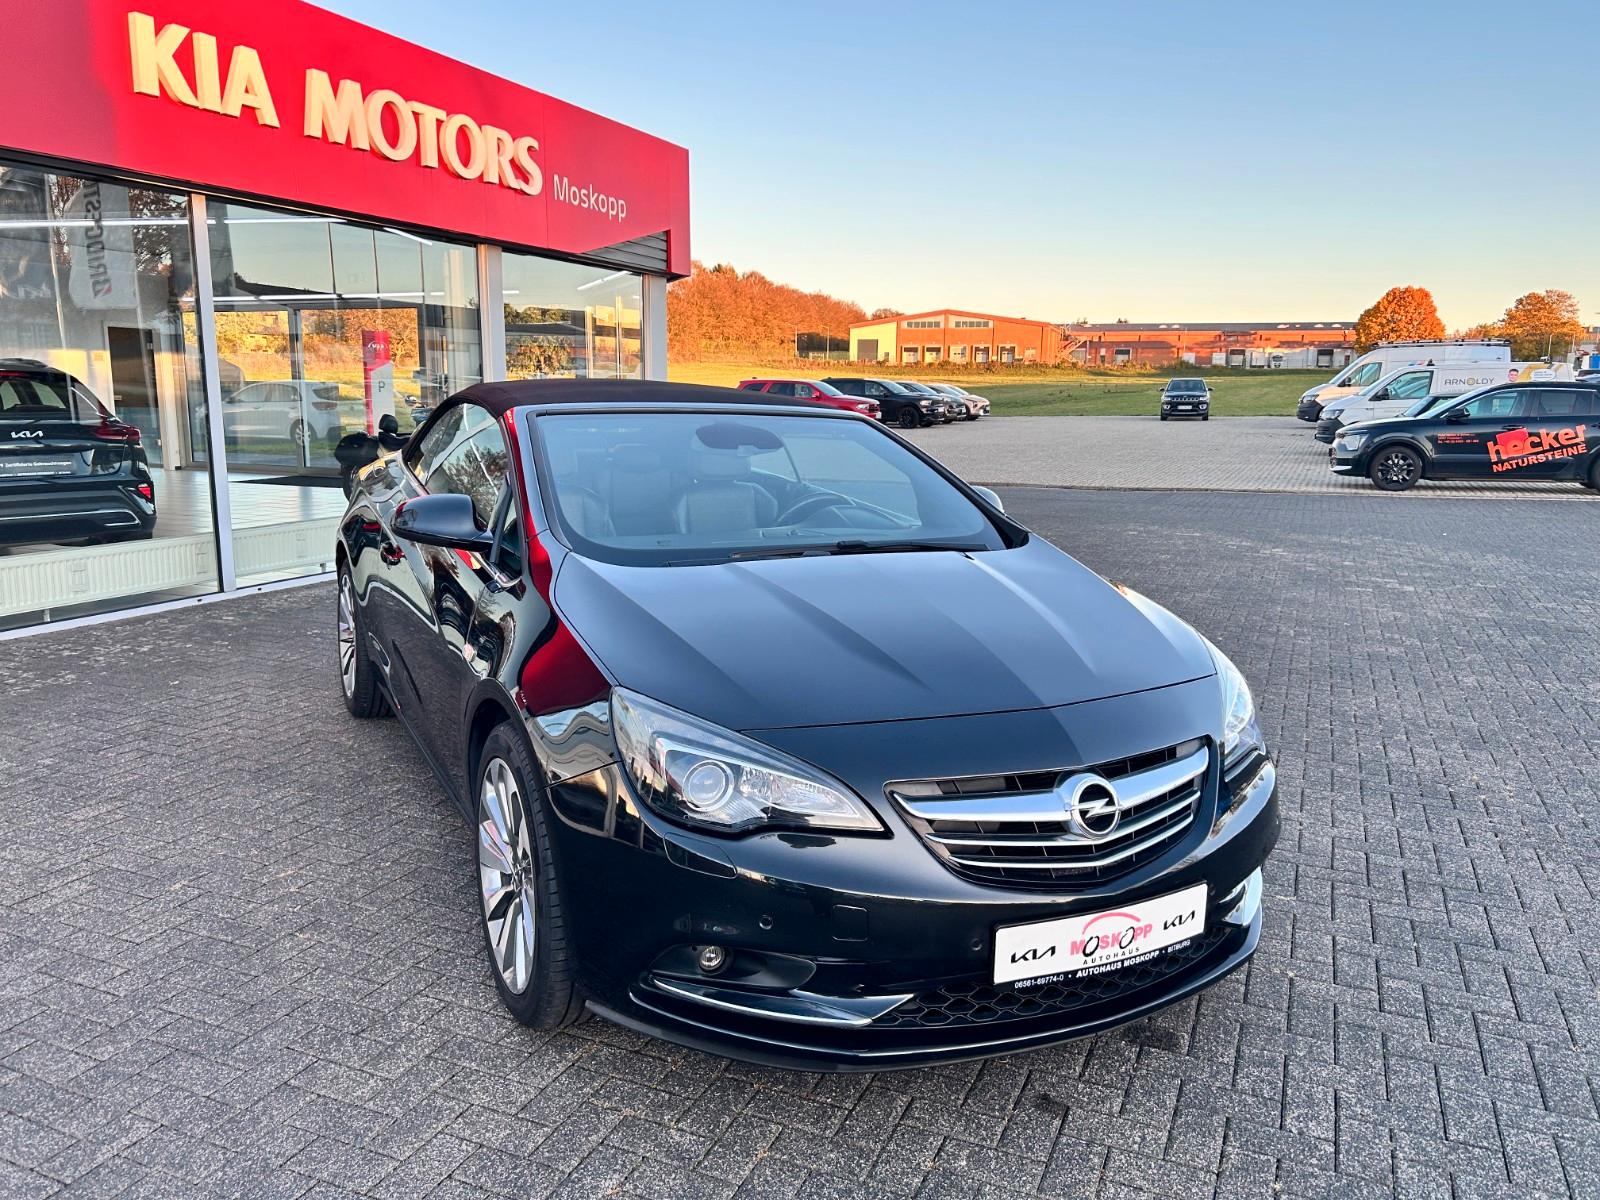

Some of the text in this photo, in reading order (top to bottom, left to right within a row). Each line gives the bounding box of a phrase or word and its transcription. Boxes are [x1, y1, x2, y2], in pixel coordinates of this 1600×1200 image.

[128, 11, 543, 196] KIA MOTORS
[554, 174, 627, 223] Moskopp
[1444, 377, 1495, 386] ARNOLDY
[1492, 443, 1588, 473] NATURSTEINE
[1070, 923, 1153, 957] MOSKOPP
[1076, 961, 1122, 978] AUTOHAUS
[1123, 949, 1160, 967] MOSKOPP
[1083, 947, 1140, 965] AUTOHAUS
